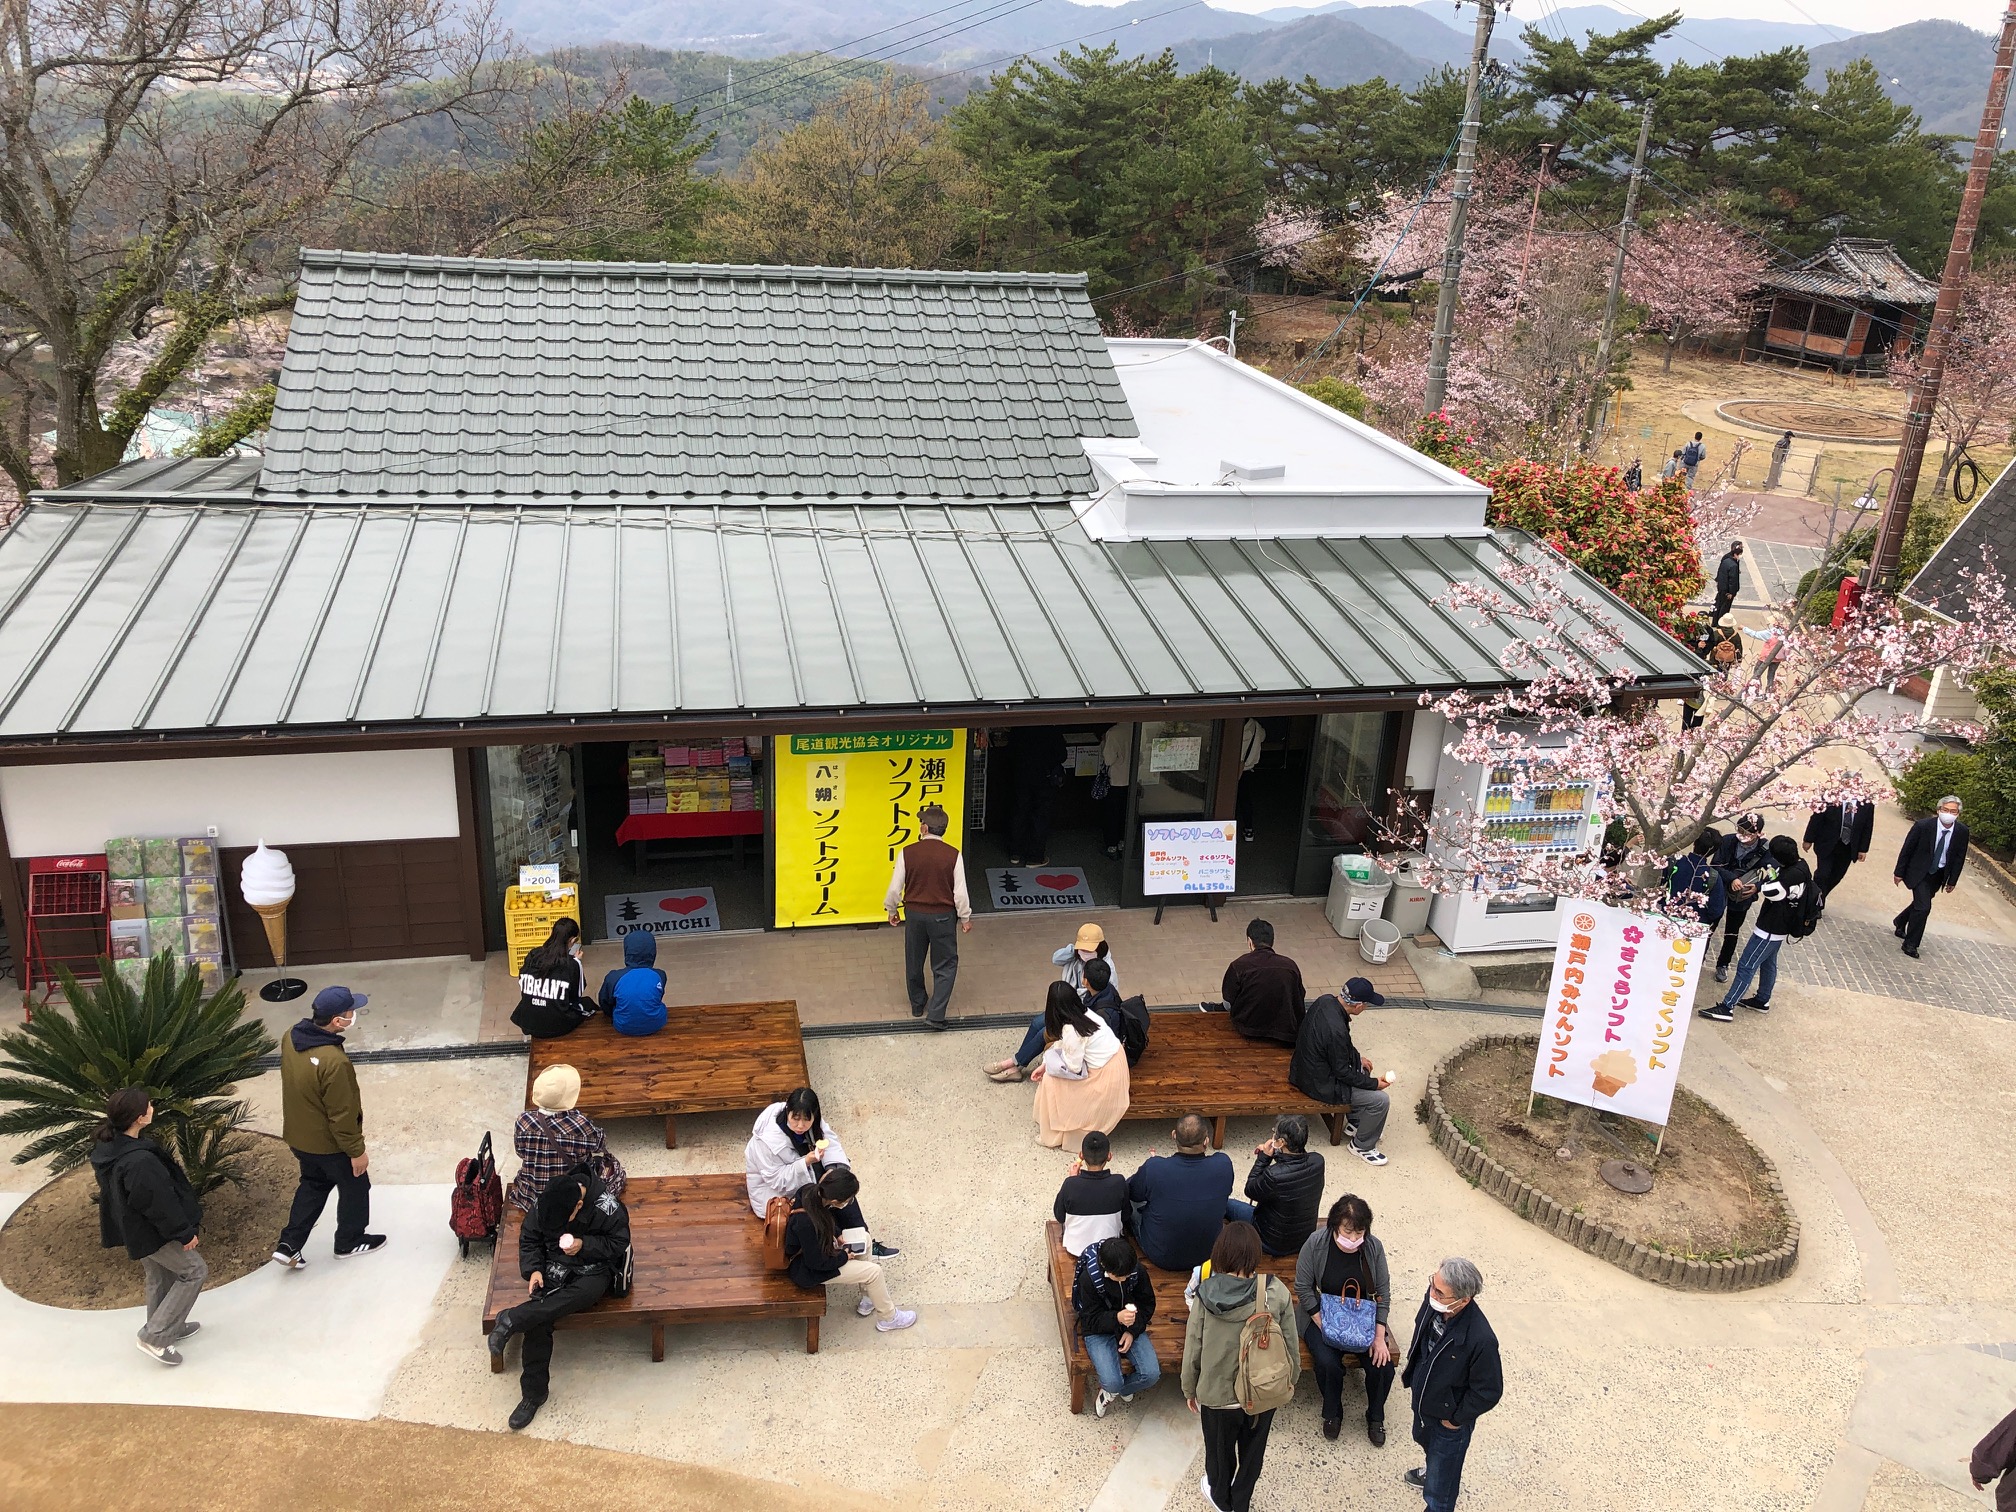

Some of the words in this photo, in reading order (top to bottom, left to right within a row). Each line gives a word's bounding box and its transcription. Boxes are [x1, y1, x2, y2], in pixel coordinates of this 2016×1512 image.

[796, 734, 948, 751] 尾道観光協会オリジナル
[884, 757, 913, 912] ソフトク
[1148, 828, 1223, 840] ソフトクリーム
[56, 859, 85, 868] Coca-Cola
[1000, 894, 1086, 905] ONOMICHI
[1351, 902, 1378, 911] ゴミ
[616, 917, 711, 935] ONOMICHI
[531, 998, 547, 1007] COLOR
[1605, 946, 1638, 1042] さくらソフト
[1549, 933, 1592, 1077] 瀬戸内みかんソフト
[1649, 956, 1688, 1070] はっさくソフト
